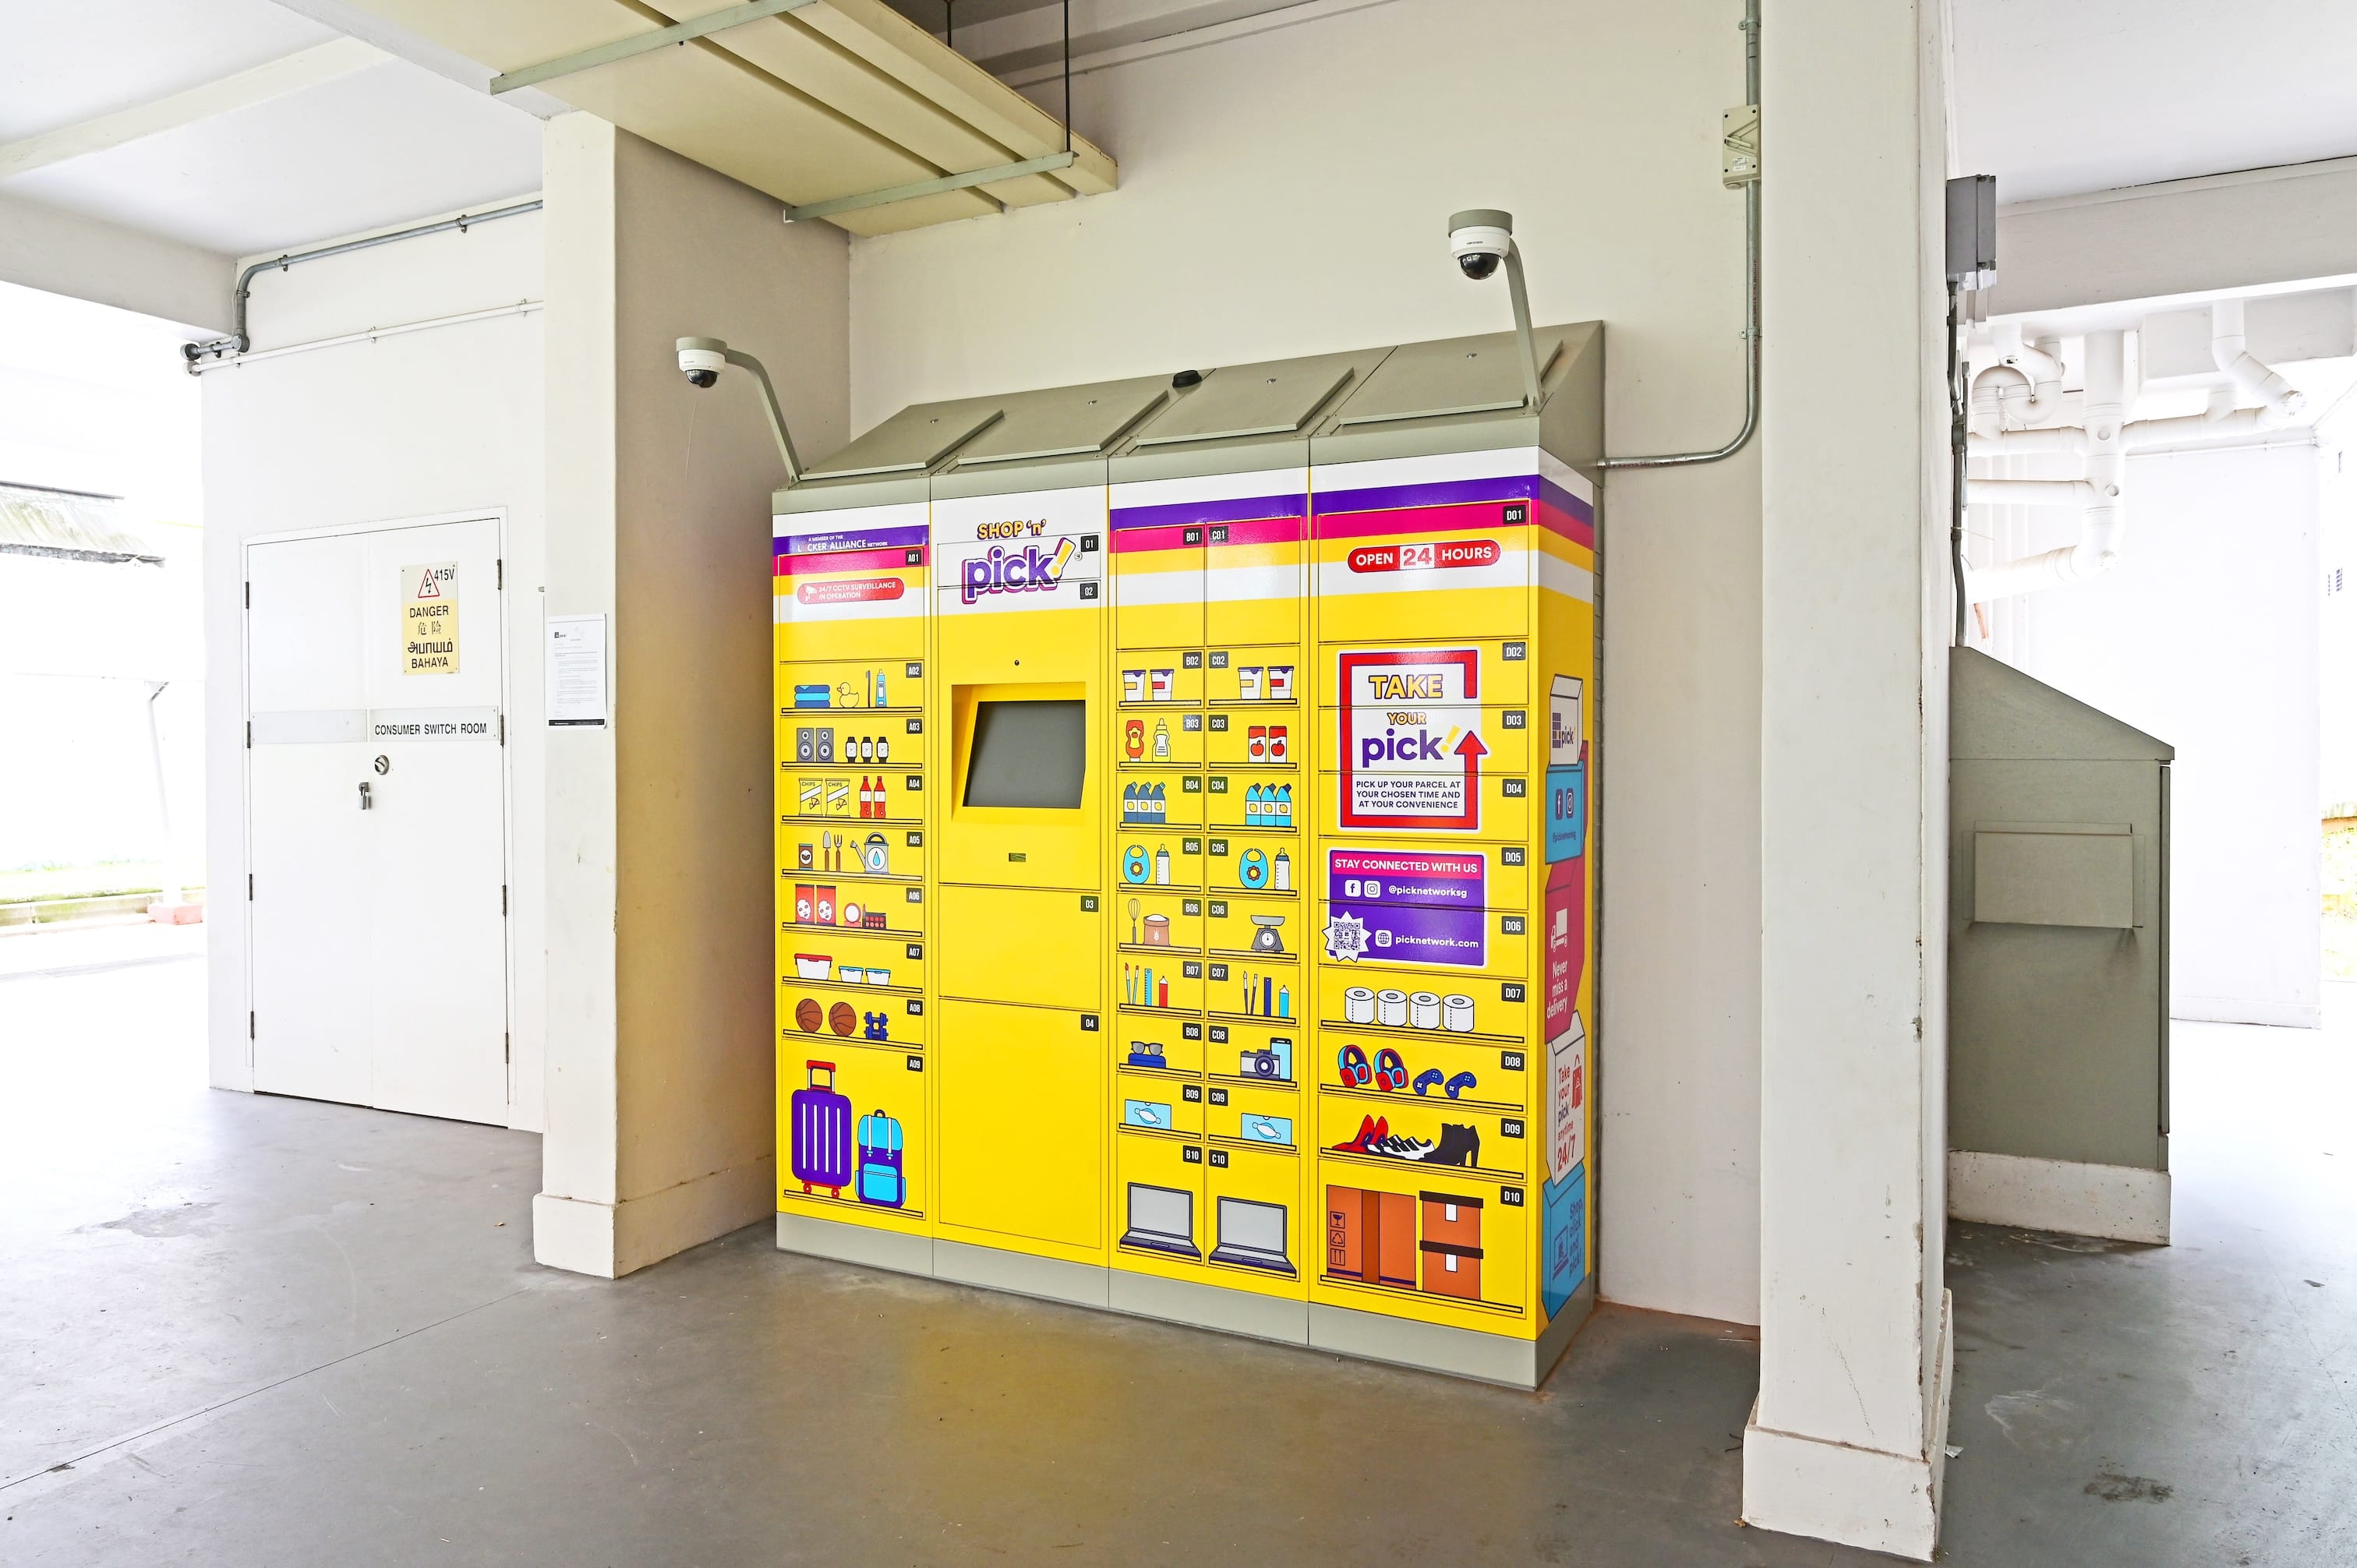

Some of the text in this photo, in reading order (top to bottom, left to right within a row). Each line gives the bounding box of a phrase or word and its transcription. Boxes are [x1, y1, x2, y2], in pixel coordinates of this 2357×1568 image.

[1506, 509, 1521, 521] D01
[977, 520, 1024, 539] SHOP
[1186, 531, 1199, 542] B01
[1211, 530, 1224, 541] C01
[829, 539, 866, 549] ALLIANCE
[1085, 539, 1094, 549] 01
[907, 553, 919, 563] A01
[1355, 546, 1492, 567] OPEN 24 HOURS
[434, 568, 455, 581] 415V
[851, 581, 896, 590] SURVEILLANCE
[1084, 586, 1094, 596] 02
[409, 605, 449, 618] DANGER
[407, 637, 453, 655] அபாயம்
[1506, 646, 1522, 657] D02
[411, 657, 449, 669] BAHAYA
[1186, 655, 1199, 666] B02
[1212, 655, 1225, 666] C02
[908, 666, 920, 676] A02
[1369, 673, 1444, 700] TAKE
[1185, 718, 1199, 729] B03
[1211, 719, 1225, 729] C03
[1387, 712, 1427, 725] YOUR
[1506, 715, 1522, 726] D03
[375, 722, 487, 736] CONSUMER SWITCH ROOM
[909, 722, 921, 731] A03
[908, 779, 920, 788] A04
[1186, 780, 1199, 790] B04
[1211, 780, 1224, 790] C04
[1506, 783, 1522, 794] D04
[1356, 790, 1461, 799] YOUR CHOSEN TIME AND
[1371, 800, 1394, 809] YOUR
[1396, 800, 1458, 809] CONVENIENCE
[909, 835, 921, 845] A05
[1185, 842, 1199, 852] B05
[1211, 842, 1225, 853] C05
[1505, 852, 1521, 863] D05
[1334, 858, 1478, 874] STAY CONNECTED WITH US
[908, 891, 920, 901] A06
[1388, 885, 1468, 899] @picknetworksg
[1085, 899, 1094, 909] 03
[1186, 902, 1199, 913] B06
[1211, 905, 1225, 915] C06
[1505, 920, 1521, 931] D06
[1395, 935, 1479, 948] picknetwork.com
[908, 947, 920, 957] A07
[1186, 965, 1199, 976] B07
[1211, 967, 1225, 978] C07
[1552, 960, 1567, 979] Never
[1505, 987, 1521, 999] D07
[1552, 979, 1564, 998] miss
[909, 1003, 921, 1013] A08
[1546, 996, 1567, 1019] delivery
[1085, 1018, 1094, 1028] 04
[1186, 1026, 1199, 1037] B08
[1211, 1029, 1225, 1040] C08
[909, 1059, 921, 1069] A09
[1504, 1055, 1521, 1068] D08
[1558, 1064, 1571, 1086] Take
[1186, 1089, 1199, 1100] B09
[1211, 1092, 1225, 1103] C09
[1557, 1083, 1571, 1106] your
[1504, 1123, 1521, 1135] D09
[1557, 1121, 1574, 1142] anytime
[1186, 1150, 1200, 1160] B10
[1211, 1153, 1225, 1165] C10
[1557, 1134, 1576, 1173] 24/7
[1504, 1191, 1520, 1203] D10
